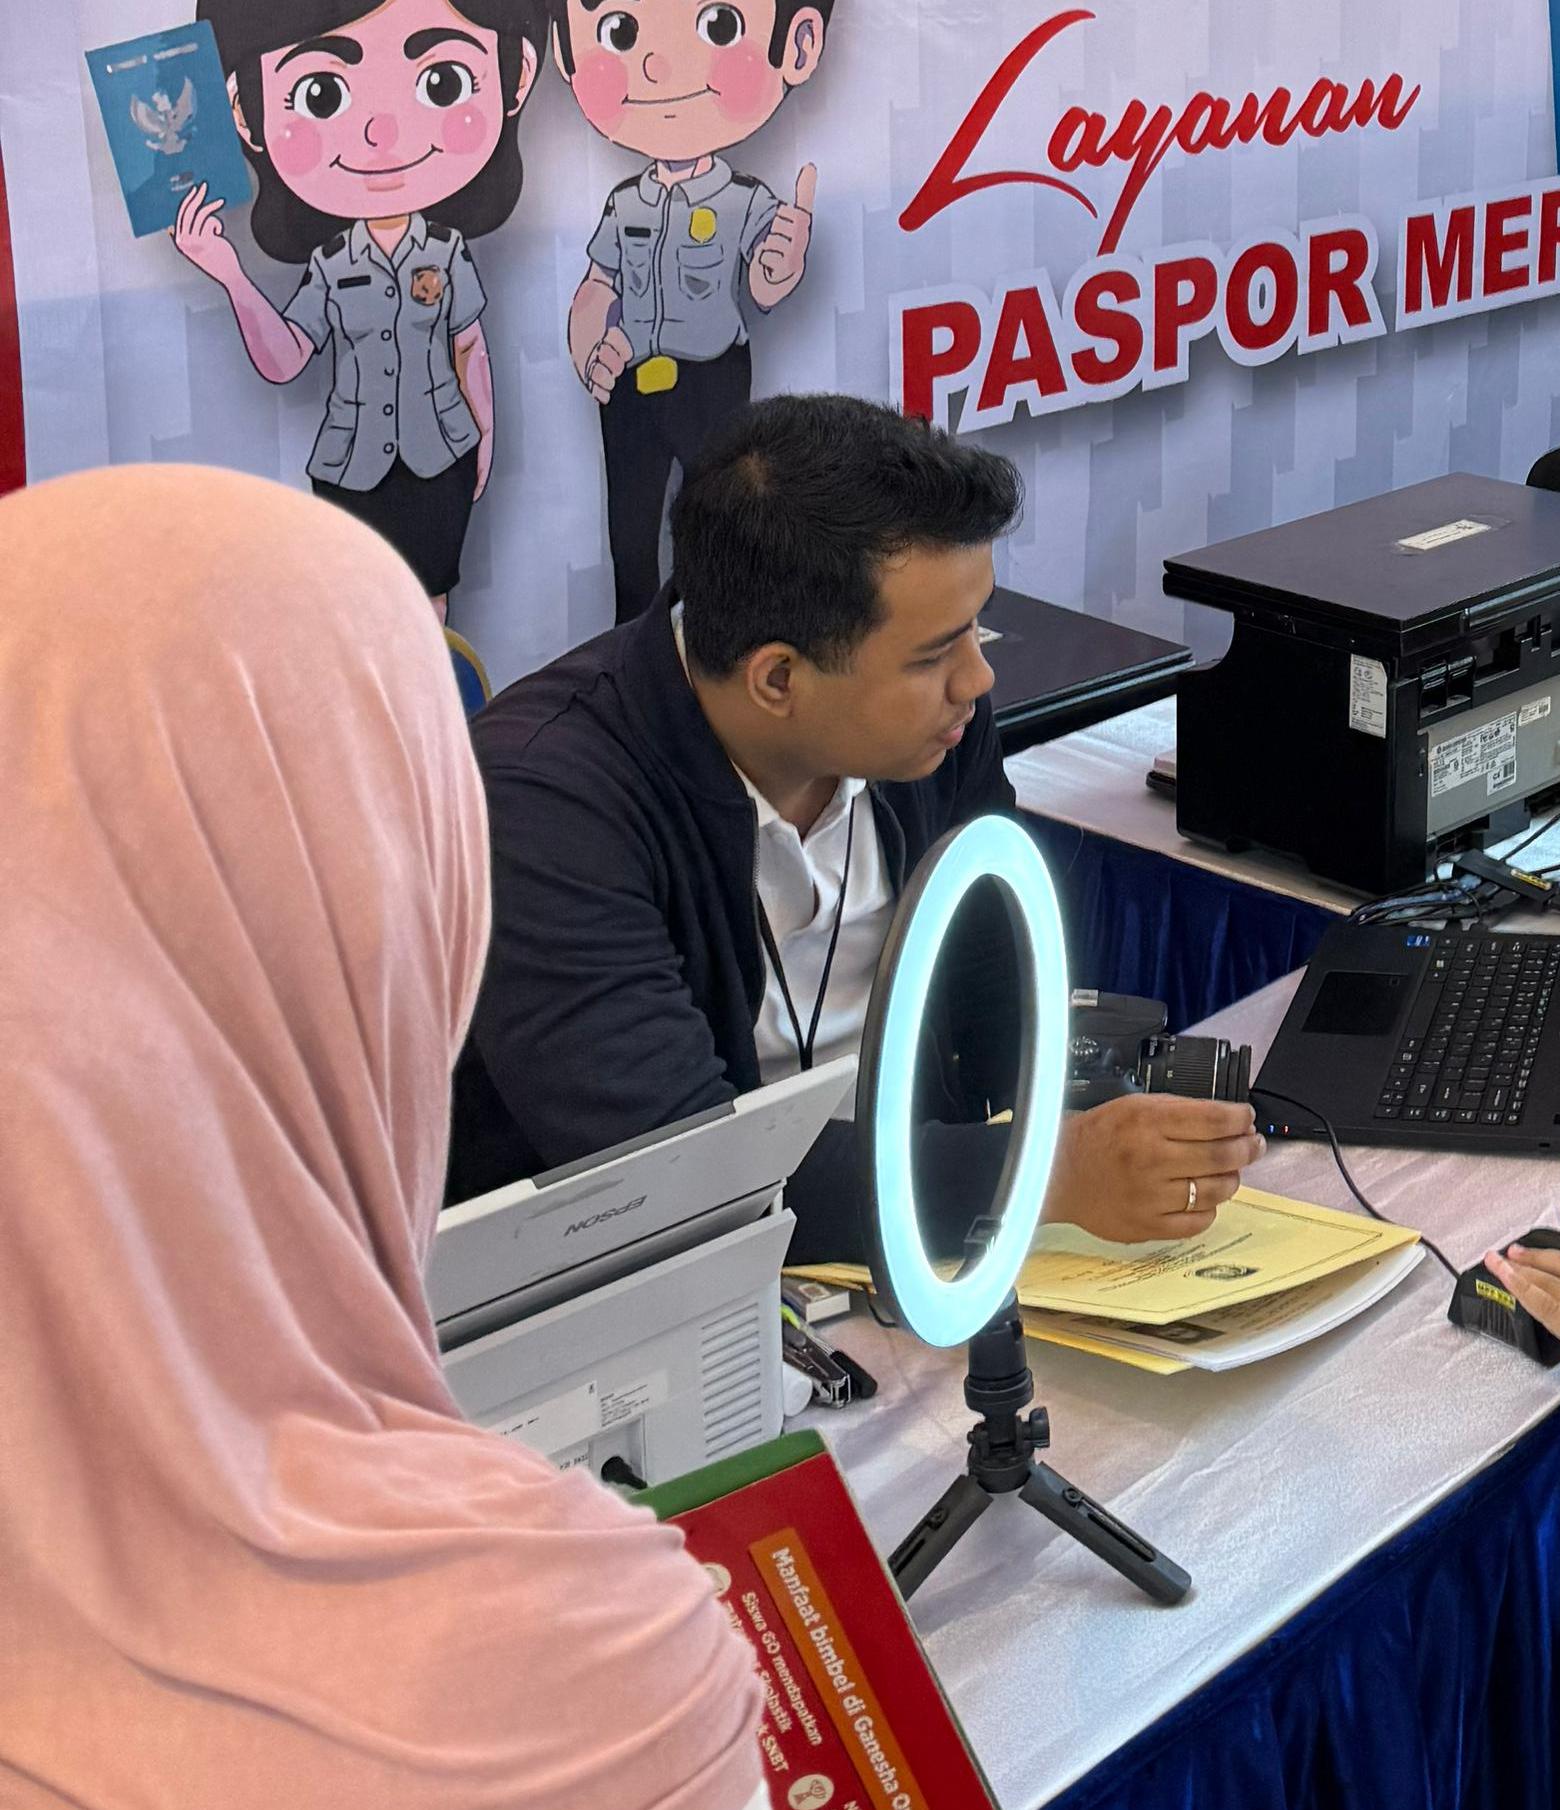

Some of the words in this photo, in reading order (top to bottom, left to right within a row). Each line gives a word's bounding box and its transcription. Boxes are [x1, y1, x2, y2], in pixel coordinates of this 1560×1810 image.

[897, 9, 1421, 257] Layanan
[901, 227, 1373, 422] PASPOR
[564, 1195, 647, 1237] EPSON
[772, 1546, 822, 1627] Manfaat
[741, 1591, 768, 1633] Siswa
[761, 1629, 781, 1656] GO
[771, 1652, 824, 1747] mendapatkan
[809, 1623, 856, 1694] bimbel
[842, 1694, 867, 1717] di
[761, 1734, 790, 1773] SNBT
[853, 1714, 901, 1796] Ganesha
